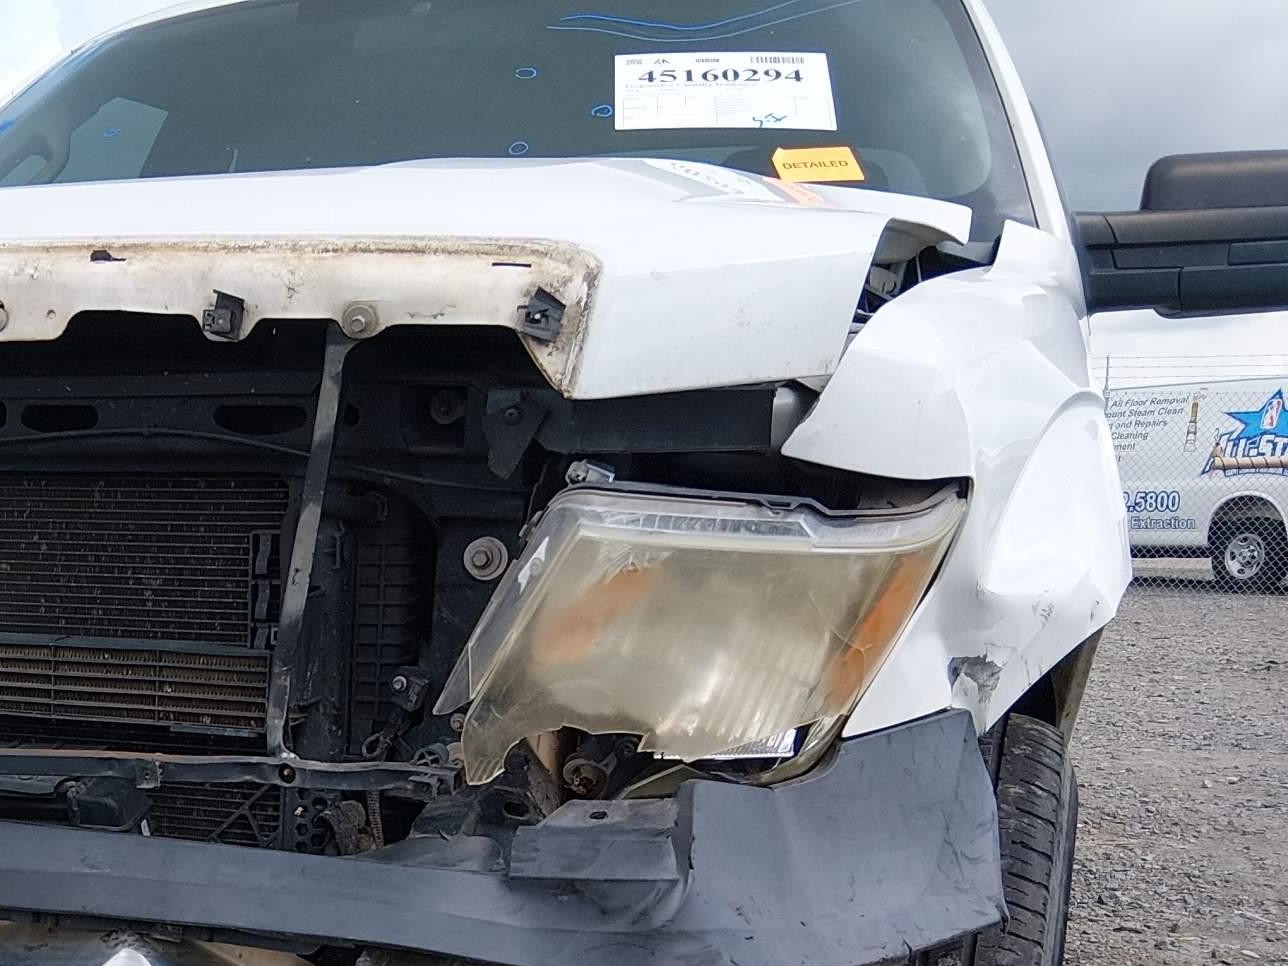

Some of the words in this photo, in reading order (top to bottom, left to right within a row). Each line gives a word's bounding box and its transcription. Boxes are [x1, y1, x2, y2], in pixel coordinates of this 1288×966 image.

[638, 68, 803, 83] 45160294
[782, 160, 849, 170] DETAILED
[1124, 399, 1148, 407] Floor
[1150, 396, 1189, 406] Removal
[1106, 409, 1127, 418] ount
[1128, 409, 1156, 418] Steam
[1158, 407, 1185, 416] Clean
[1115, 421, 1132, 429] and
[1134, 419, 1169, 429] Repairs
[1112, 431, 1149, 440] Cleaning
[1114, 442, 1136, 450] ment
[1131, 515, 1196, 529] Extraction
